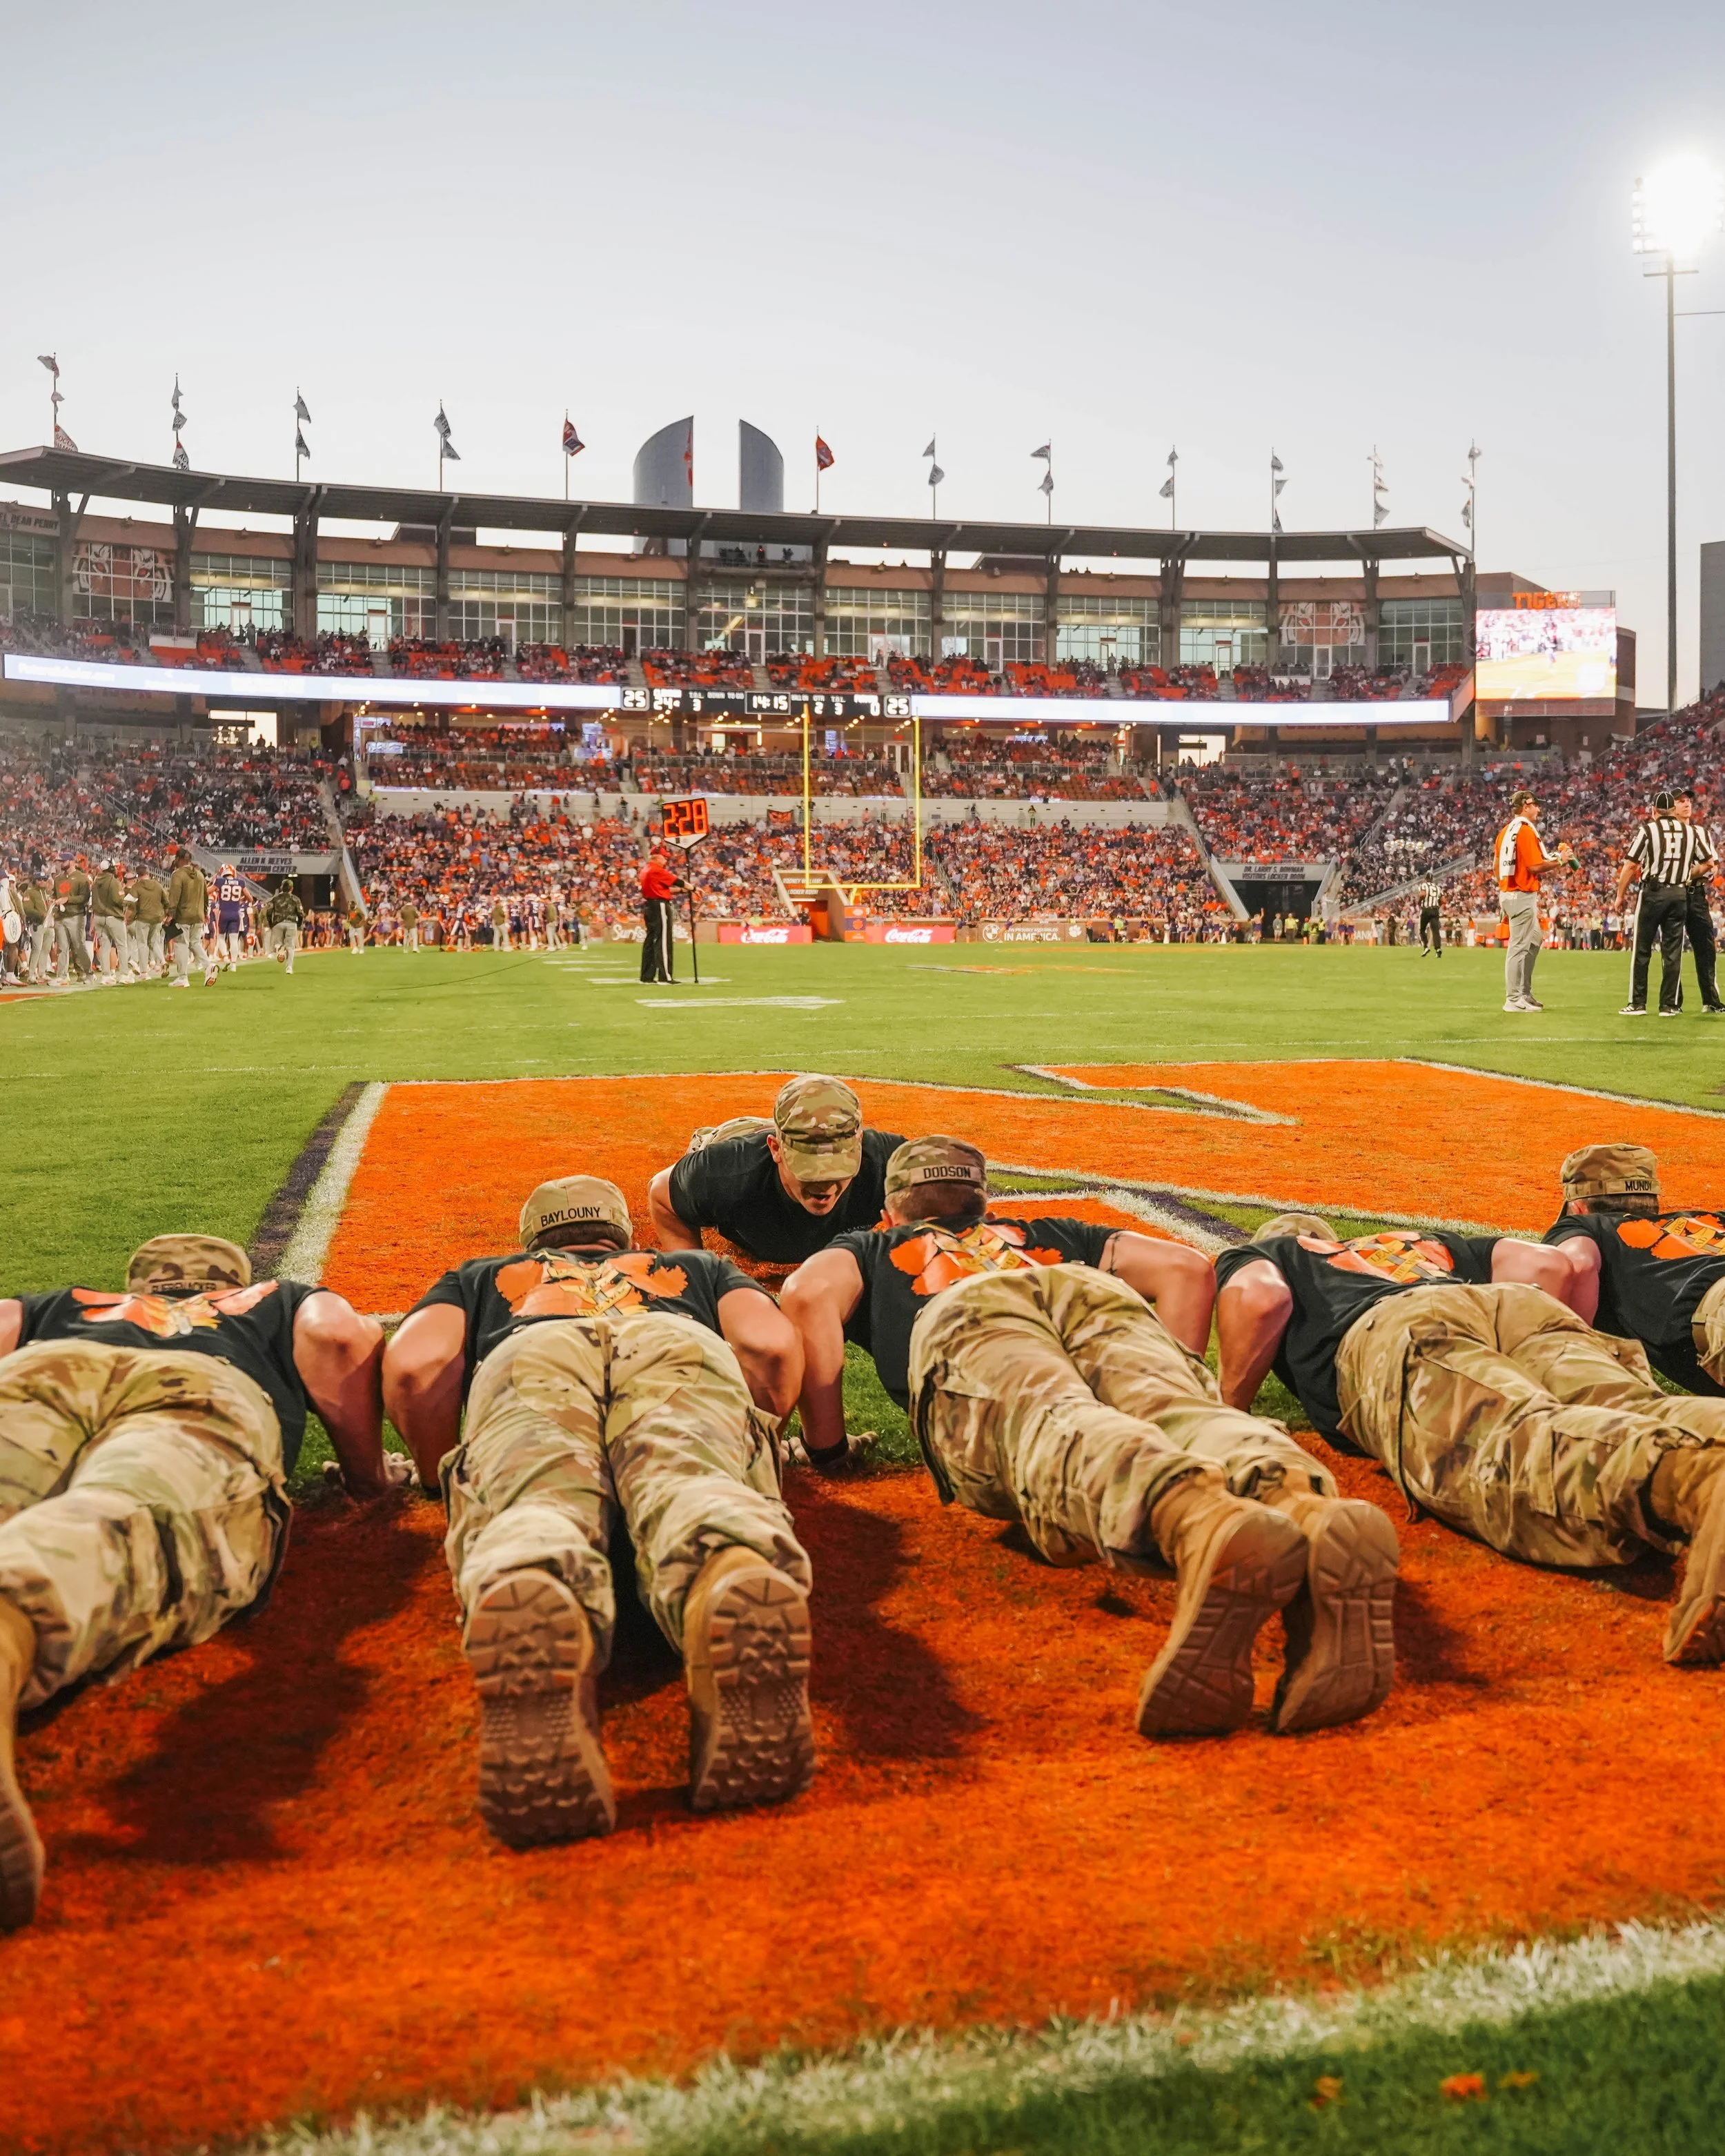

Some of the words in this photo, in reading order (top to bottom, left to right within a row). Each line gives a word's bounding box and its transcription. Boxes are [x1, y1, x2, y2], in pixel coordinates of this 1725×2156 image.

[1512, 591, 1581, 610] TIGERS
[623, 690, 647, 708] 25
[693, 698, 701, 712] 3
[752, 694, 788, 711] 14:15
[887, 698, 910, 715] 25
[814, 701, 823, 714] 2
[834, 702, 843, 716] 3
[870, 701, 880, 716] 0
[663, 799, 708, 838] 2:28
[1664, 832, 1684, 859] H
[272, 865, 297, 873] CENTER
[221, 884, 241, 902] 89
[1003, 933, 1014, 941] IN
[1015, 933, 1061, 942] AMEICA.
[923, 1166, 972, 1179] DODSON
[1624, 1180, 1653, 1191] MUNDY
[540, 1207, 600, 1227] BAYLOUNY
